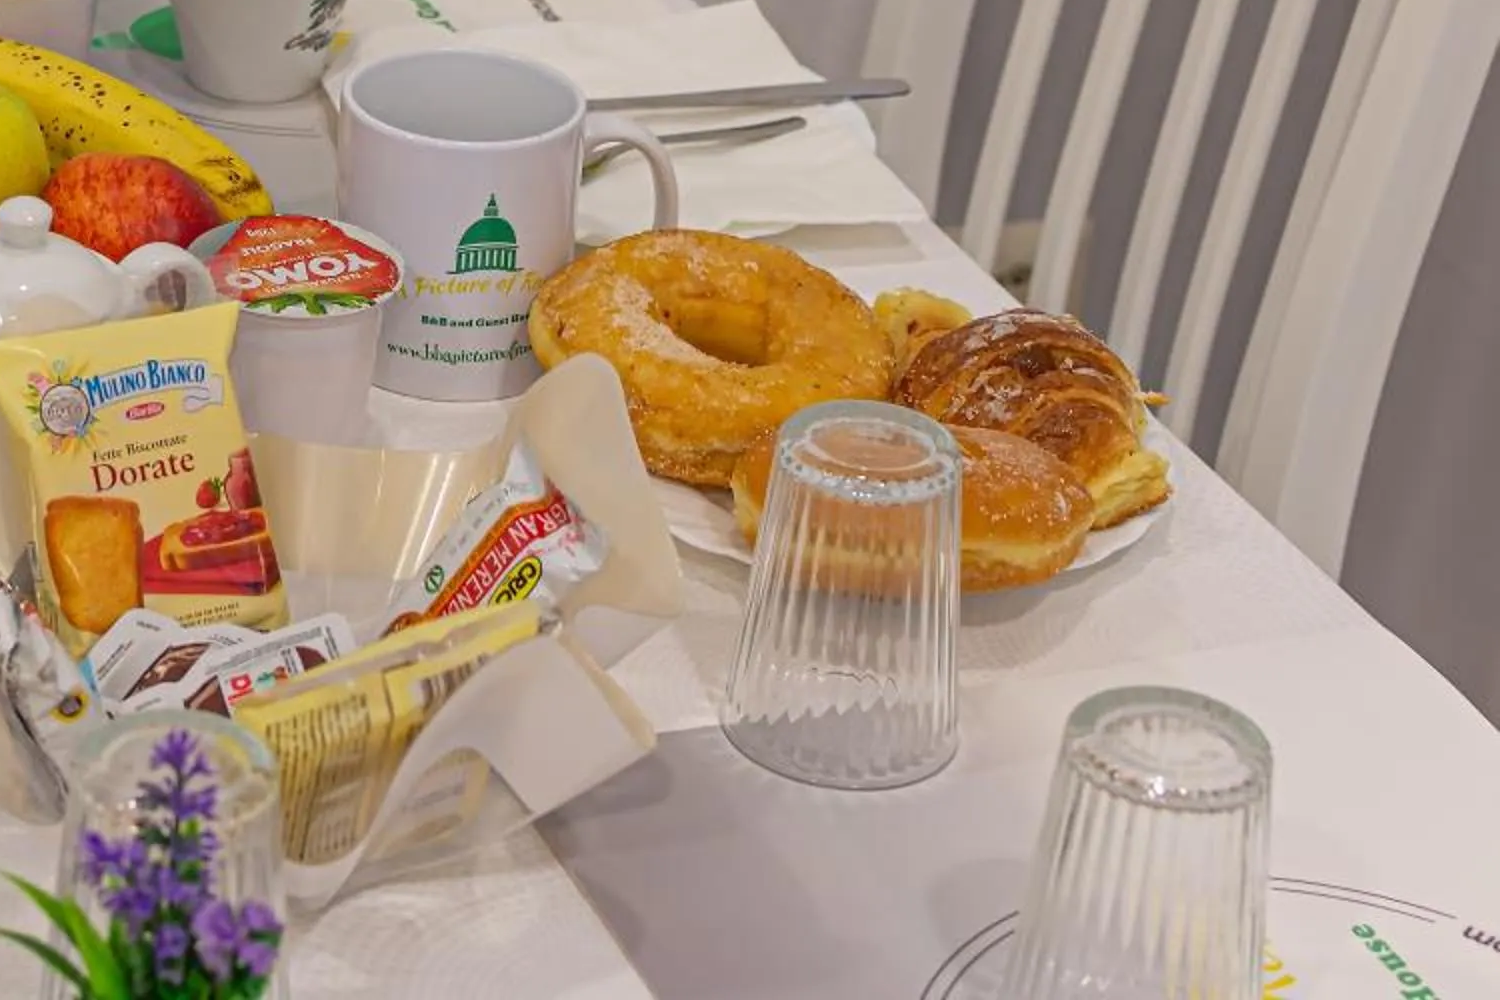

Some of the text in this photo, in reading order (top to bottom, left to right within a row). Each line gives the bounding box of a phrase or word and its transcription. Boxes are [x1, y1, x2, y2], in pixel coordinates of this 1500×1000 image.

[224, 251, 377, 290] YOMO
[414, 275, 493, 298] Picture
[449, 317, 474, 328] and
[475, 316, 510, 328] Guest
[85, 359, 206, 408] MULINO BIANCO
[89, 451, 196, 493] Dorate
[507, 502, 570, 546] GRAN
[442, 541, 515, 618] MEREND
[494, 561, 537, 604] CRIC
